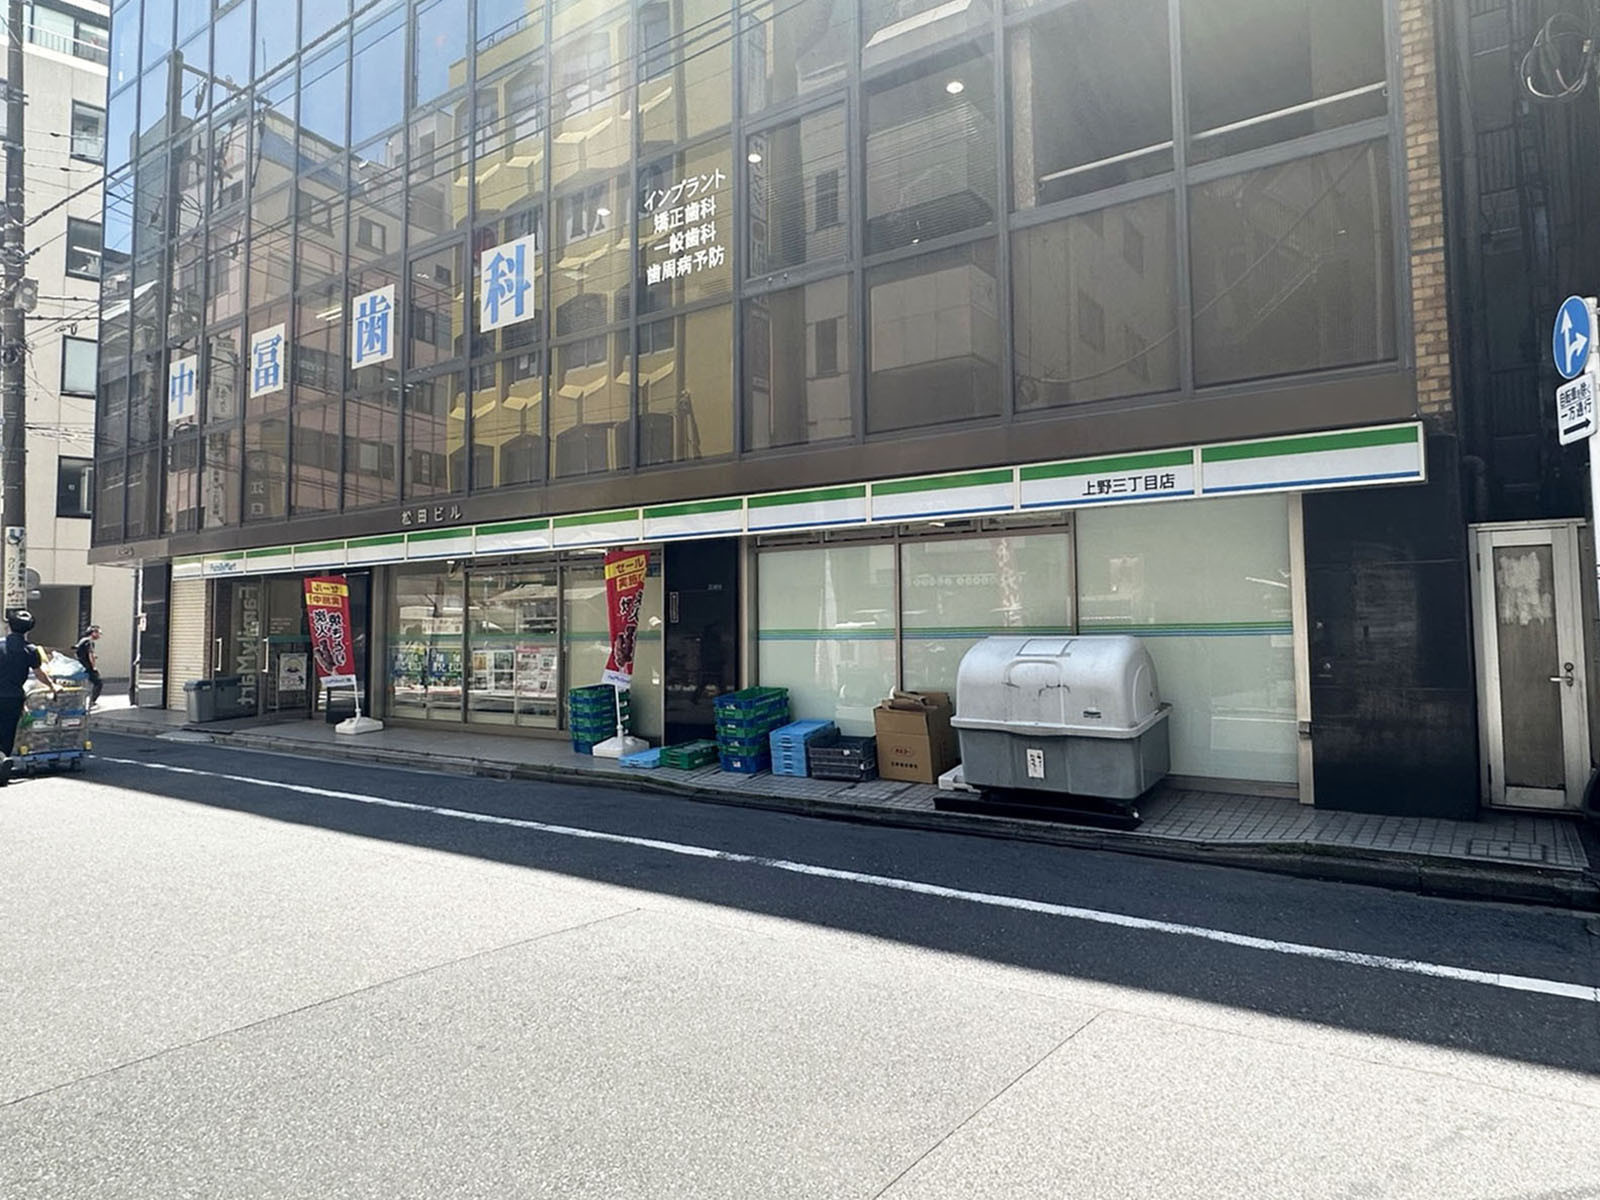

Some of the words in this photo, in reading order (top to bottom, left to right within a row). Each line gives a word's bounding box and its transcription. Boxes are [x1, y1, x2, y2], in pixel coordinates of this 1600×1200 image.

[643, 167, 726, 211] インプラント
[653, 195, 717, 234] 矯正歯科
[653, 221, 717, 254] 一般歯科
[646, 245, 726, 286] 歯周病予防
[1561, 398, 1592, 420] 一方通行
[1082, 473, 1175, 496] 上野三丁目店
[616, 557, 644, 573] セール
